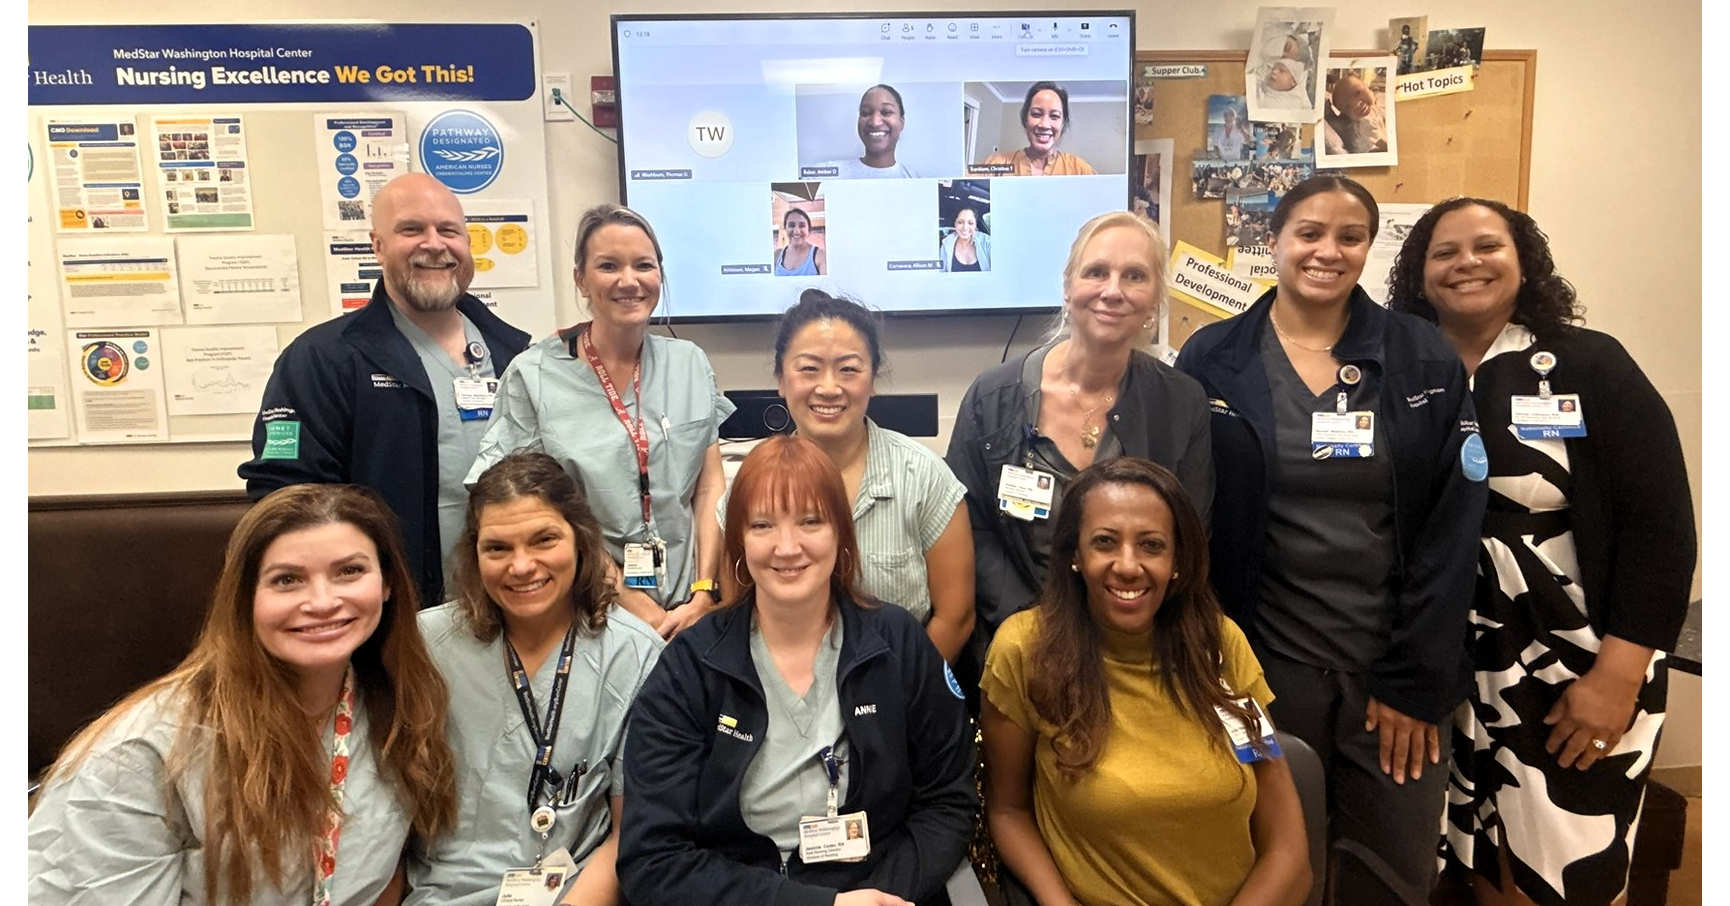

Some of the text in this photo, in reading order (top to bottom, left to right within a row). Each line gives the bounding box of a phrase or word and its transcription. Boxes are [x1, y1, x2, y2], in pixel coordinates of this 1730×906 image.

[113, 46, 313, 61] MedStar Washington Hospital Center
[34, 69, 94, 86] Health
[116, 63, 475, 89] Nursing Excellence We Got This!
[1152, 66, 1200, 76] Supper Club
[1403, 74, 1463, 92] Hot Topics
[432, 128, 489, 137] PATHWAY
[695, 126, 726, 141] TW
[432, 137, 491, 145] DESIGNATED
[1185, 257, 1253, 293] Professional
[1175, 272, 1248, 312] Development
[594, 364, 620, 401] ROLL TIDE
[1335, 448, 1350, 456] RN
[636, 577, 653, 586] RN
[854, 704, 877, 716] ANNE
[732, 728, 754, 743] Health
